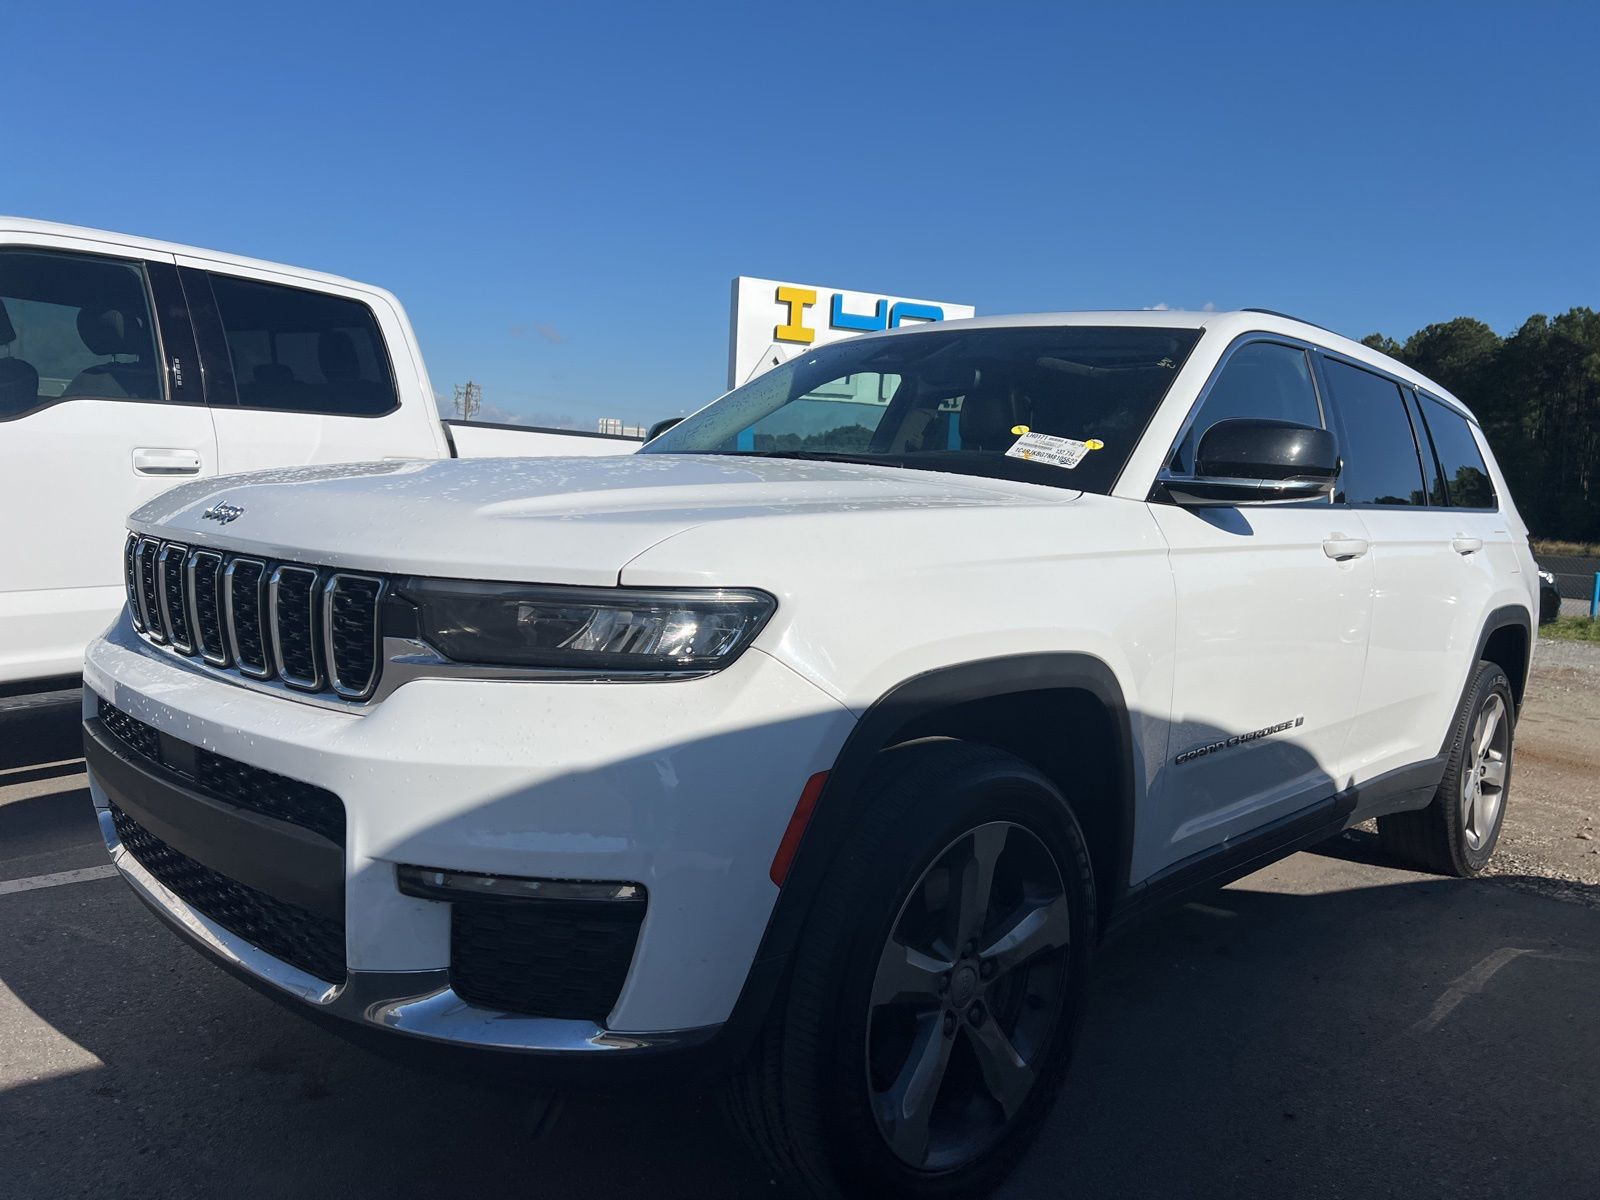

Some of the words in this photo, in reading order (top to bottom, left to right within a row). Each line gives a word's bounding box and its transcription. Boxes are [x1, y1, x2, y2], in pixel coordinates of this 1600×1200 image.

[202, 500, 245, 526] Jeep
[1175, 741, 1225, 765] GRAND
[1226, 720, 1294, 748] CHEROKEE
